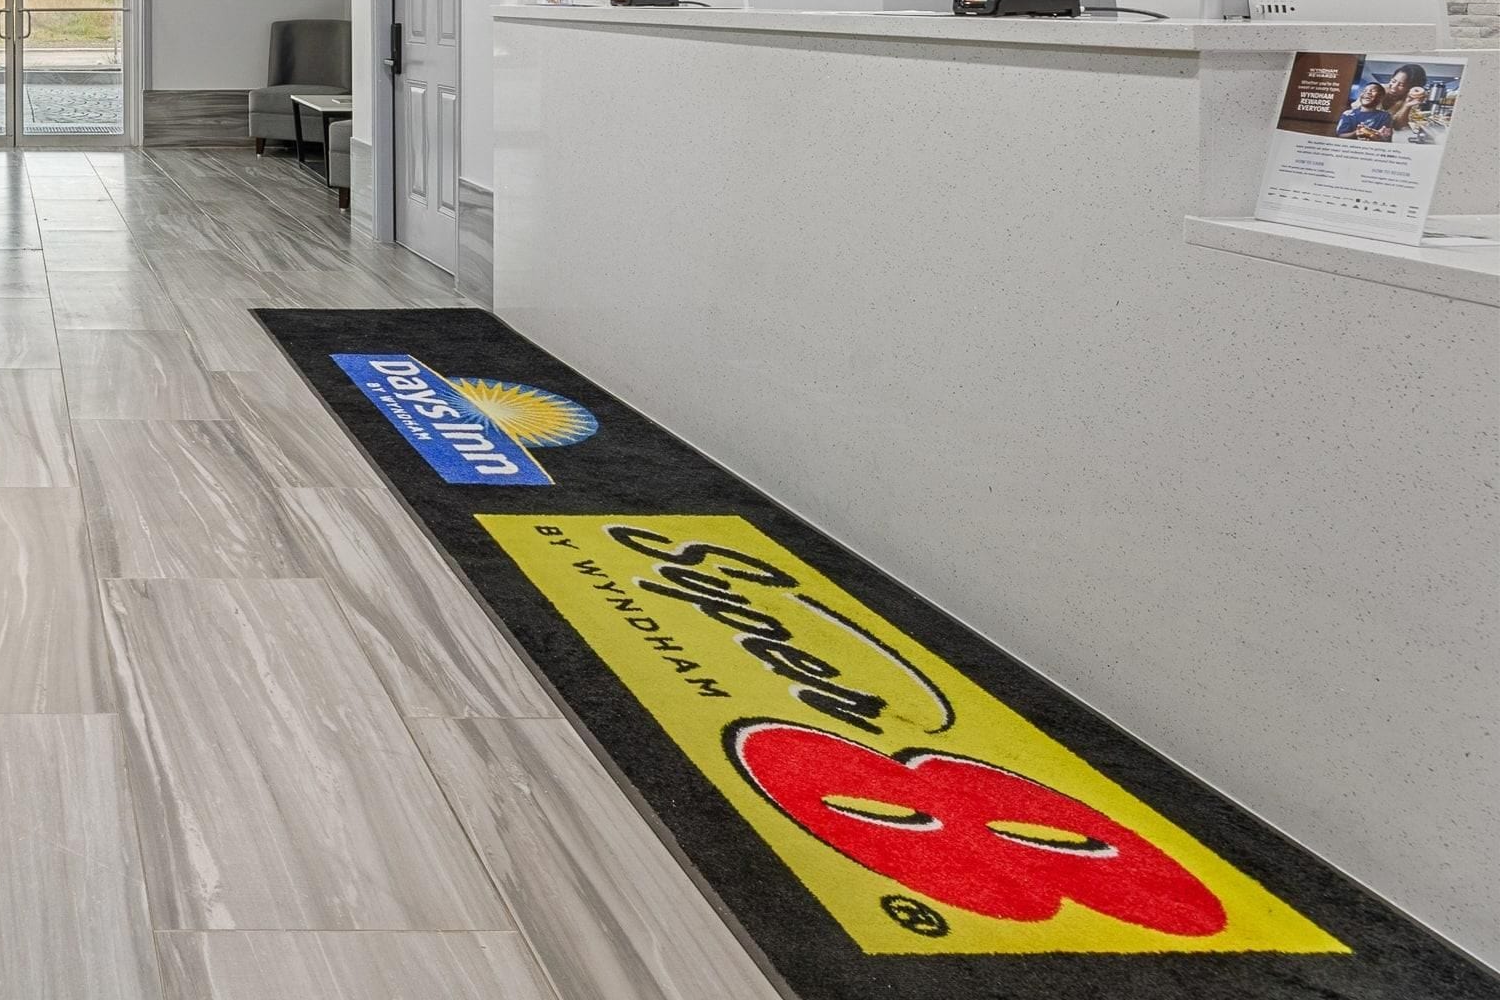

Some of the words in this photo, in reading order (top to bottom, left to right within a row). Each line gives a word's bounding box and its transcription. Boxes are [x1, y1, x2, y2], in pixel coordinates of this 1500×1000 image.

[1297, 104, 1331, 113] EVERYONE.
[1300, 92, 1334, 100] WYNDHAM
[1300, 98, 1331, 106] REWARDS
[365, 382, 384, 394] BY
[378, 396, 433, 441] WYNDHAM
[368, 360, 461, 420] Days
[432, 422, 520, 476] Inn
[534, 525, 580, 550] BY
[572, 559, 732, 698] WYNDHAM
[601, 523, 890, 736] Super
[722, 715, 1229, 939] 8
